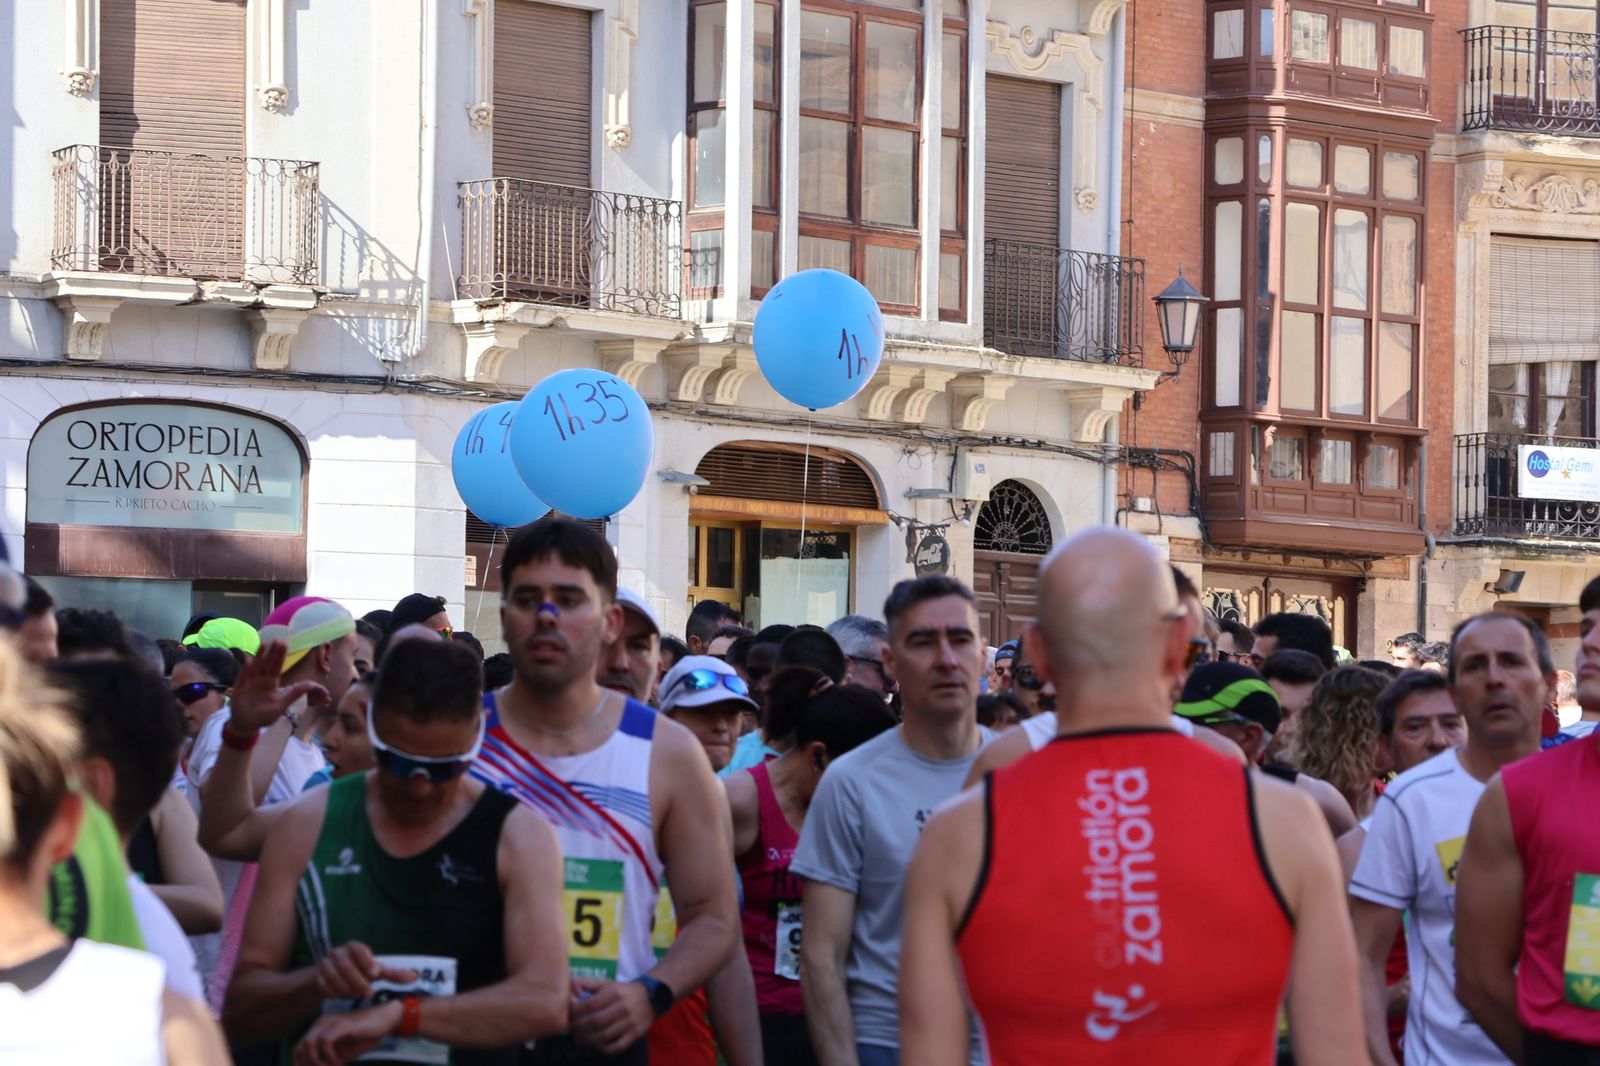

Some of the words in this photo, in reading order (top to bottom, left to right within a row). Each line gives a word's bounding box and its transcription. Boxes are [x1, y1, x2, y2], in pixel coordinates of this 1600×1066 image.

[838, 327, 869, 380] 1h
[67, 420, 263, 457] ORTOPEDIA
[465, 413, 484, 456] 1h
[66, 456, 264, 494] ZAMORANA
[1528, 454, 1564, 471] Hostal
[126, 497, 168, 510] PRIETO
[170, 499, 216, 512] CACHO
[1077, 768, 1121, 900] triatlón
[1114, 766, 1163, 966] zamora
[572, 897, 603, 949] 5
